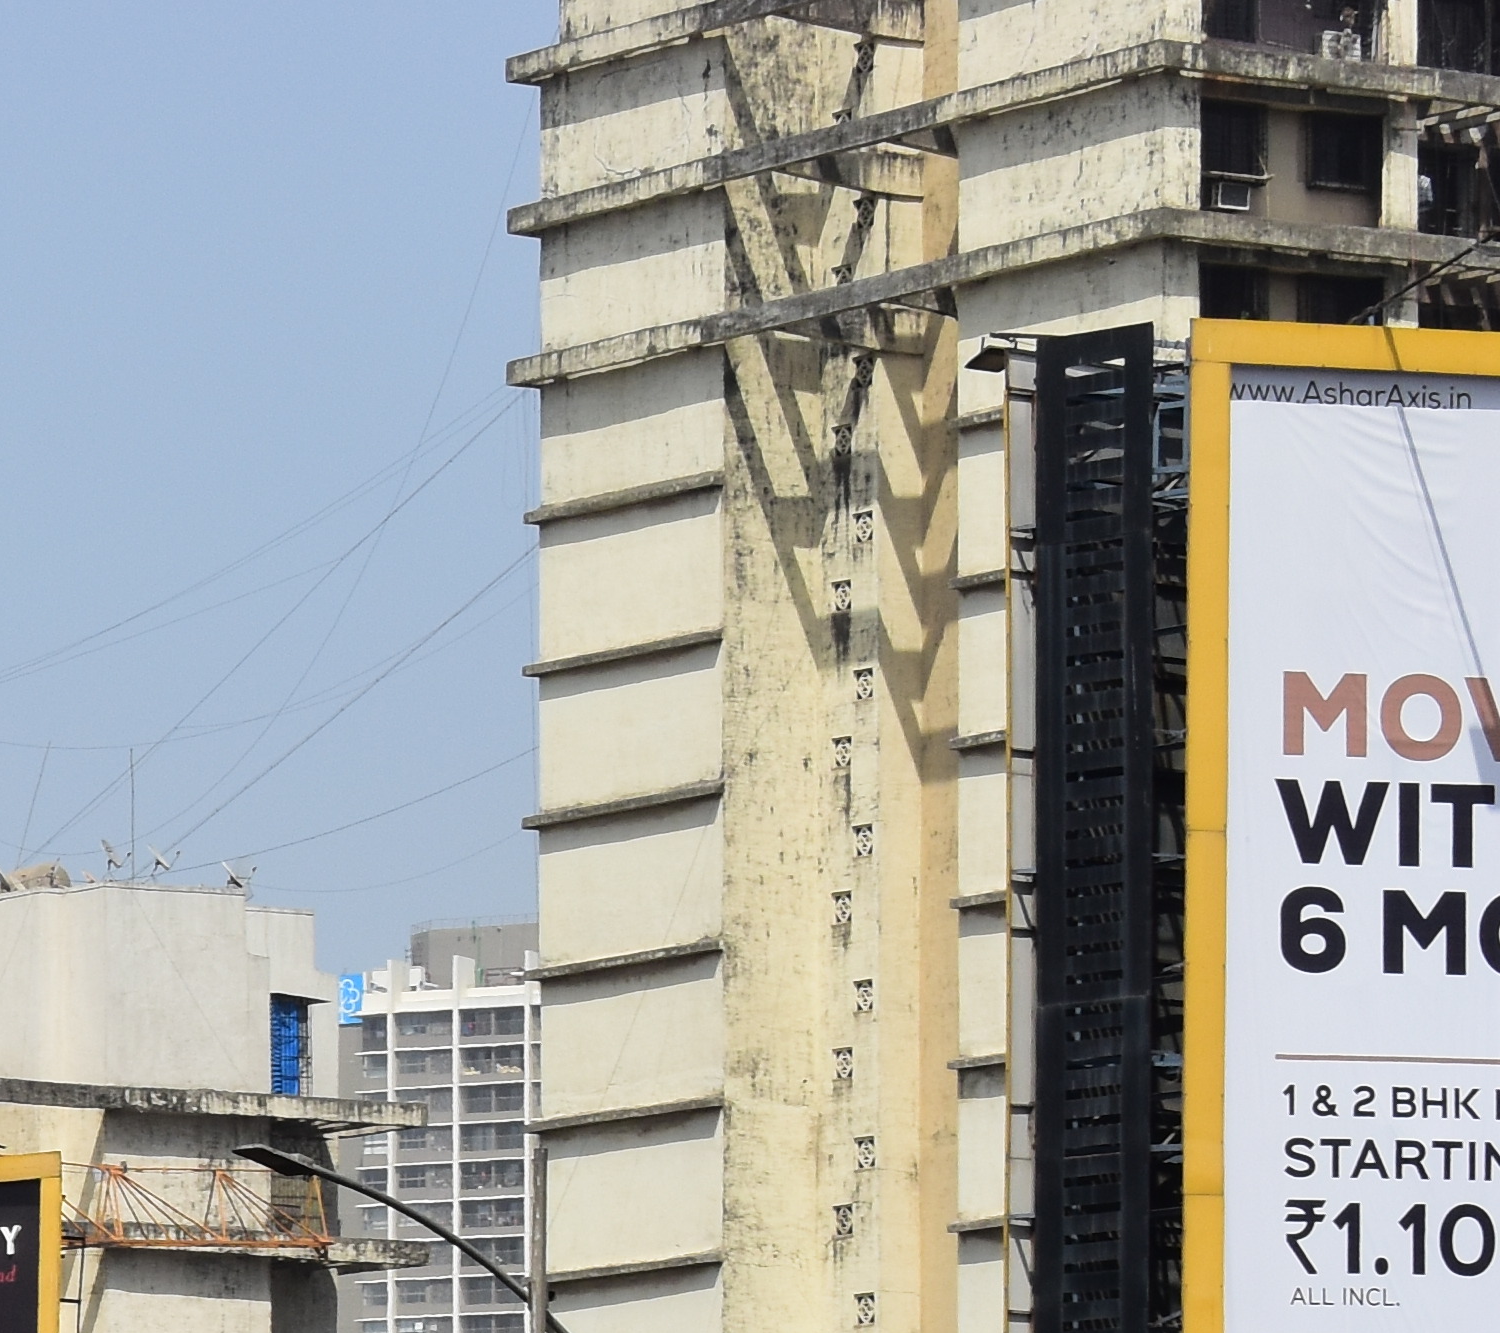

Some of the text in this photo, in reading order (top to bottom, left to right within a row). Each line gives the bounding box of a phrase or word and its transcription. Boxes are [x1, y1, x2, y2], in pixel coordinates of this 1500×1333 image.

[1274, 778, 1496, 868] WIT
[1281, 886, 1500, 976] 6 M
[1282, 1084, 1295, 1116] 1
[1312, 1084, 1338, 1117] &
[1353, 1085, 1376, 1117] 2
[1392, 1086, 1480, 1120] BHK
[1284, 1199, 1496, 1277] ₹1.10
[1290, 1288, 1400, 1307] ALL INCL.
